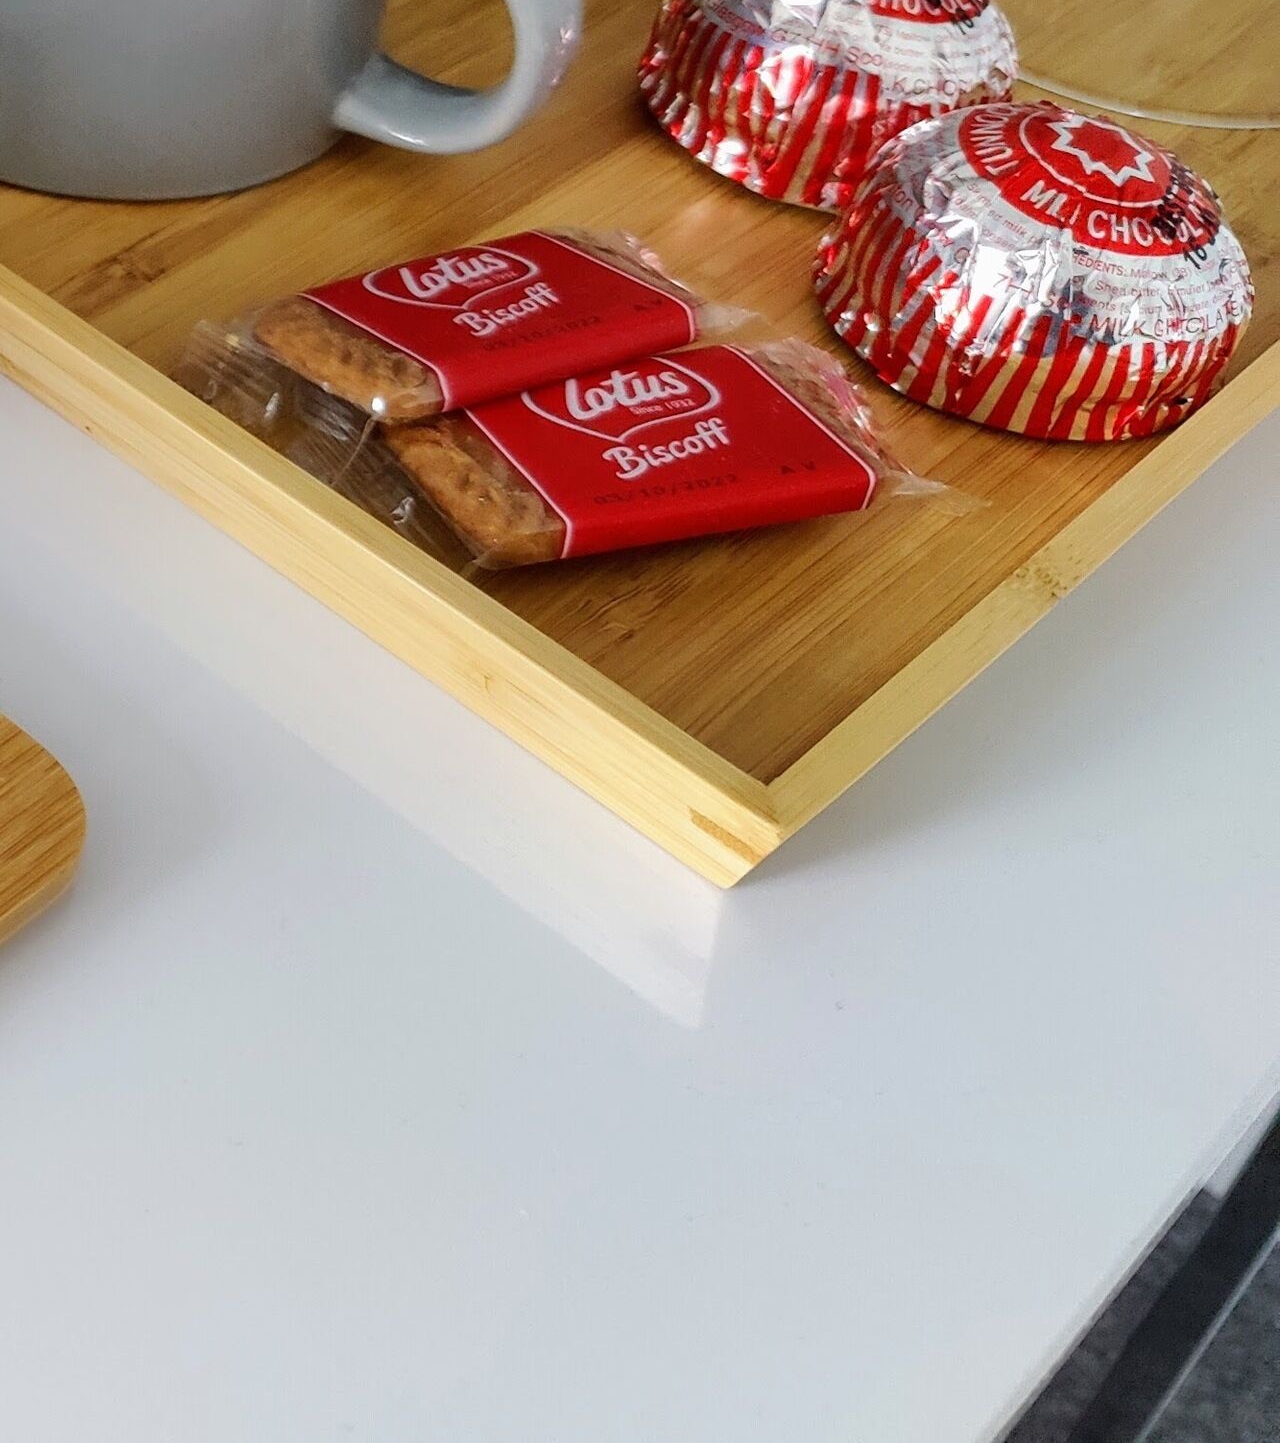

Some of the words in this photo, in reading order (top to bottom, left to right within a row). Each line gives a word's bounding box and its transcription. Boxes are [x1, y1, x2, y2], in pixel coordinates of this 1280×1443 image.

[398, 252, 509, 299] Lotus
[453, 282, 560, 336] Biscoff
[565, 370, 690, 421] Lotus
[601, 417, 730, 480] Biscoff
